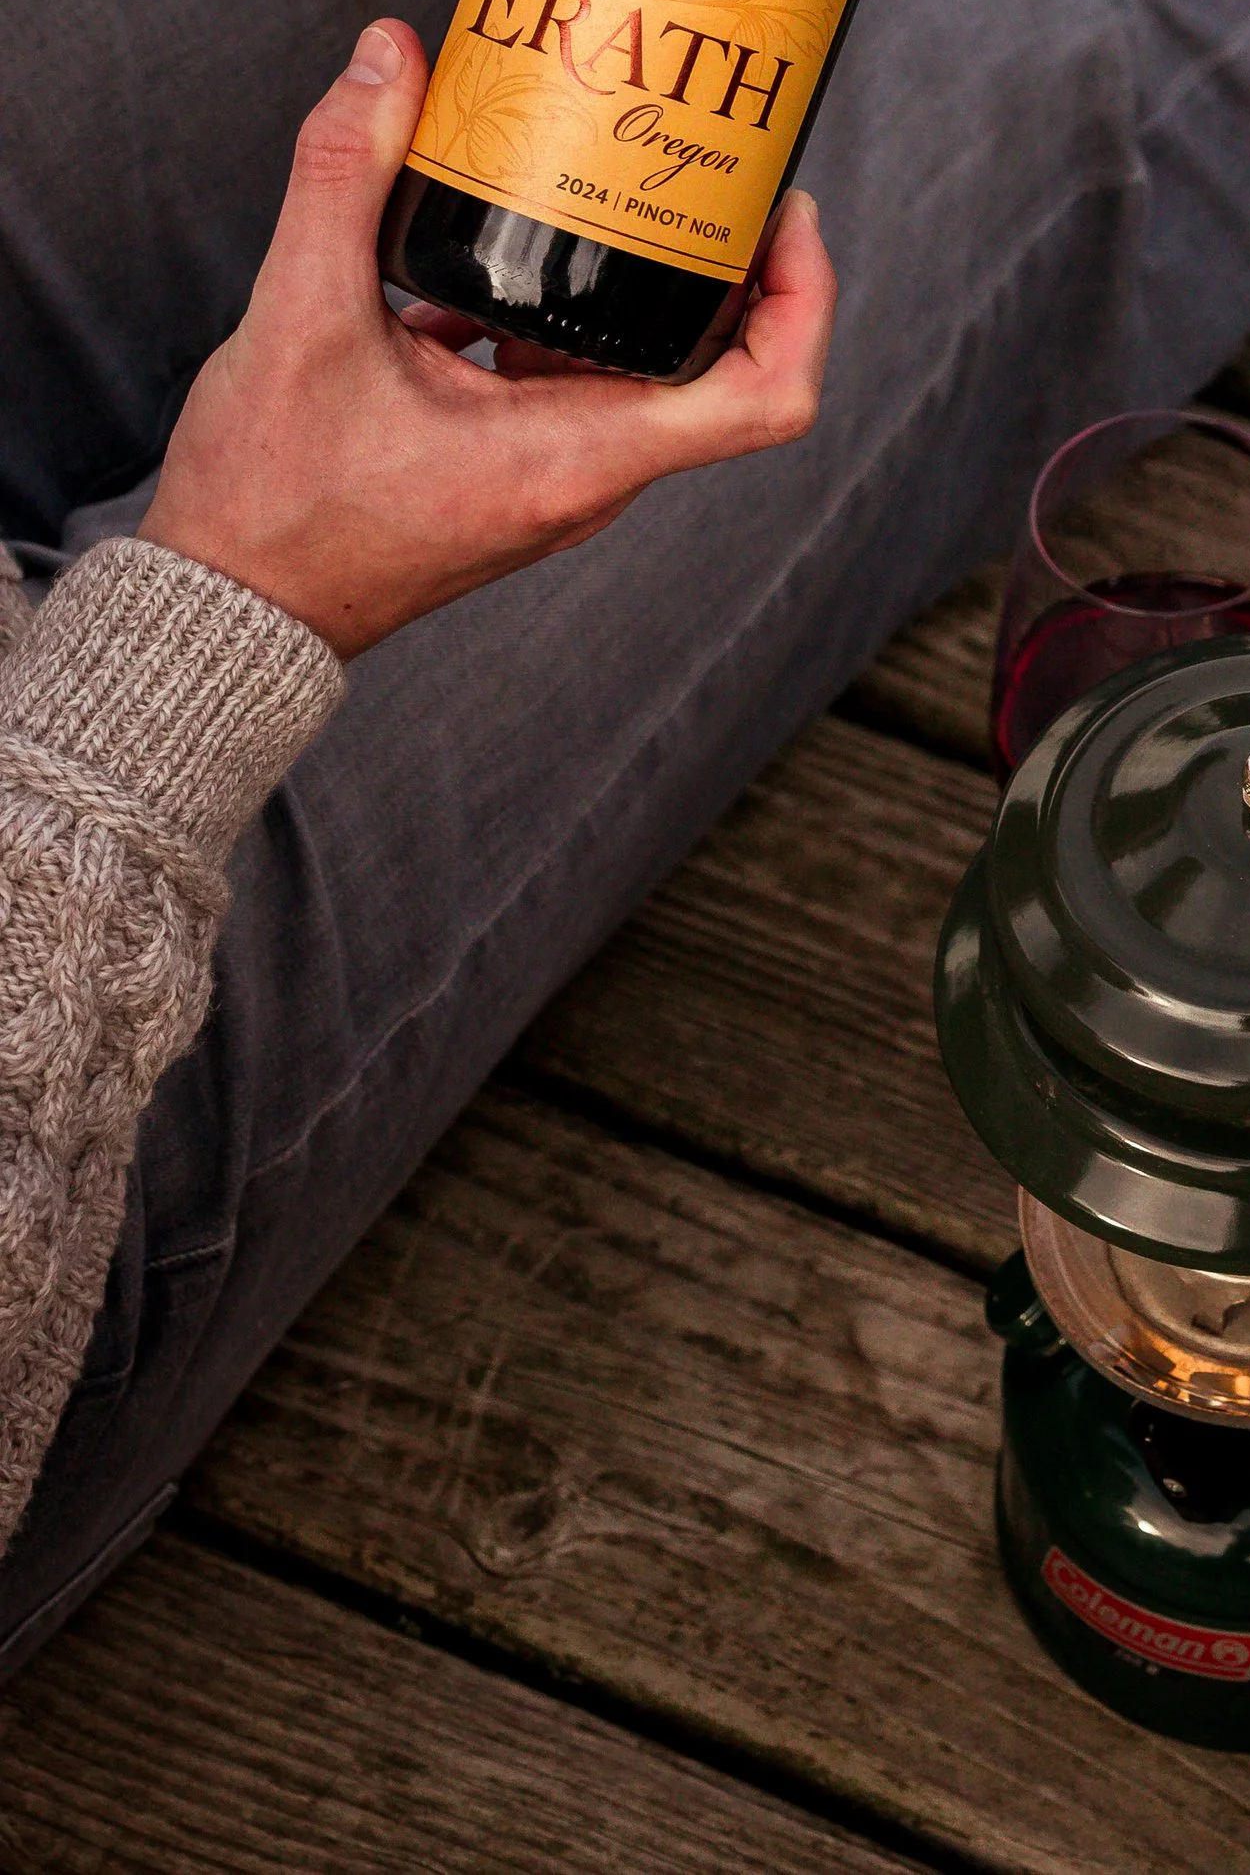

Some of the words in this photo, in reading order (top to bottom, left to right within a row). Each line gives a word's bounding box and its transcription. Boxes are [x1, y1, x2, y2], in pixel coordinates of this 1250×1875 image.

[613, 103, 740, 192] Oregon
[556, 173, 609, 204] 2024
[624, 197, 688, 229] PINOT
[689, 217, 731, 243] NOIR
[1052, 1559, 1206, 1659] Coleman
